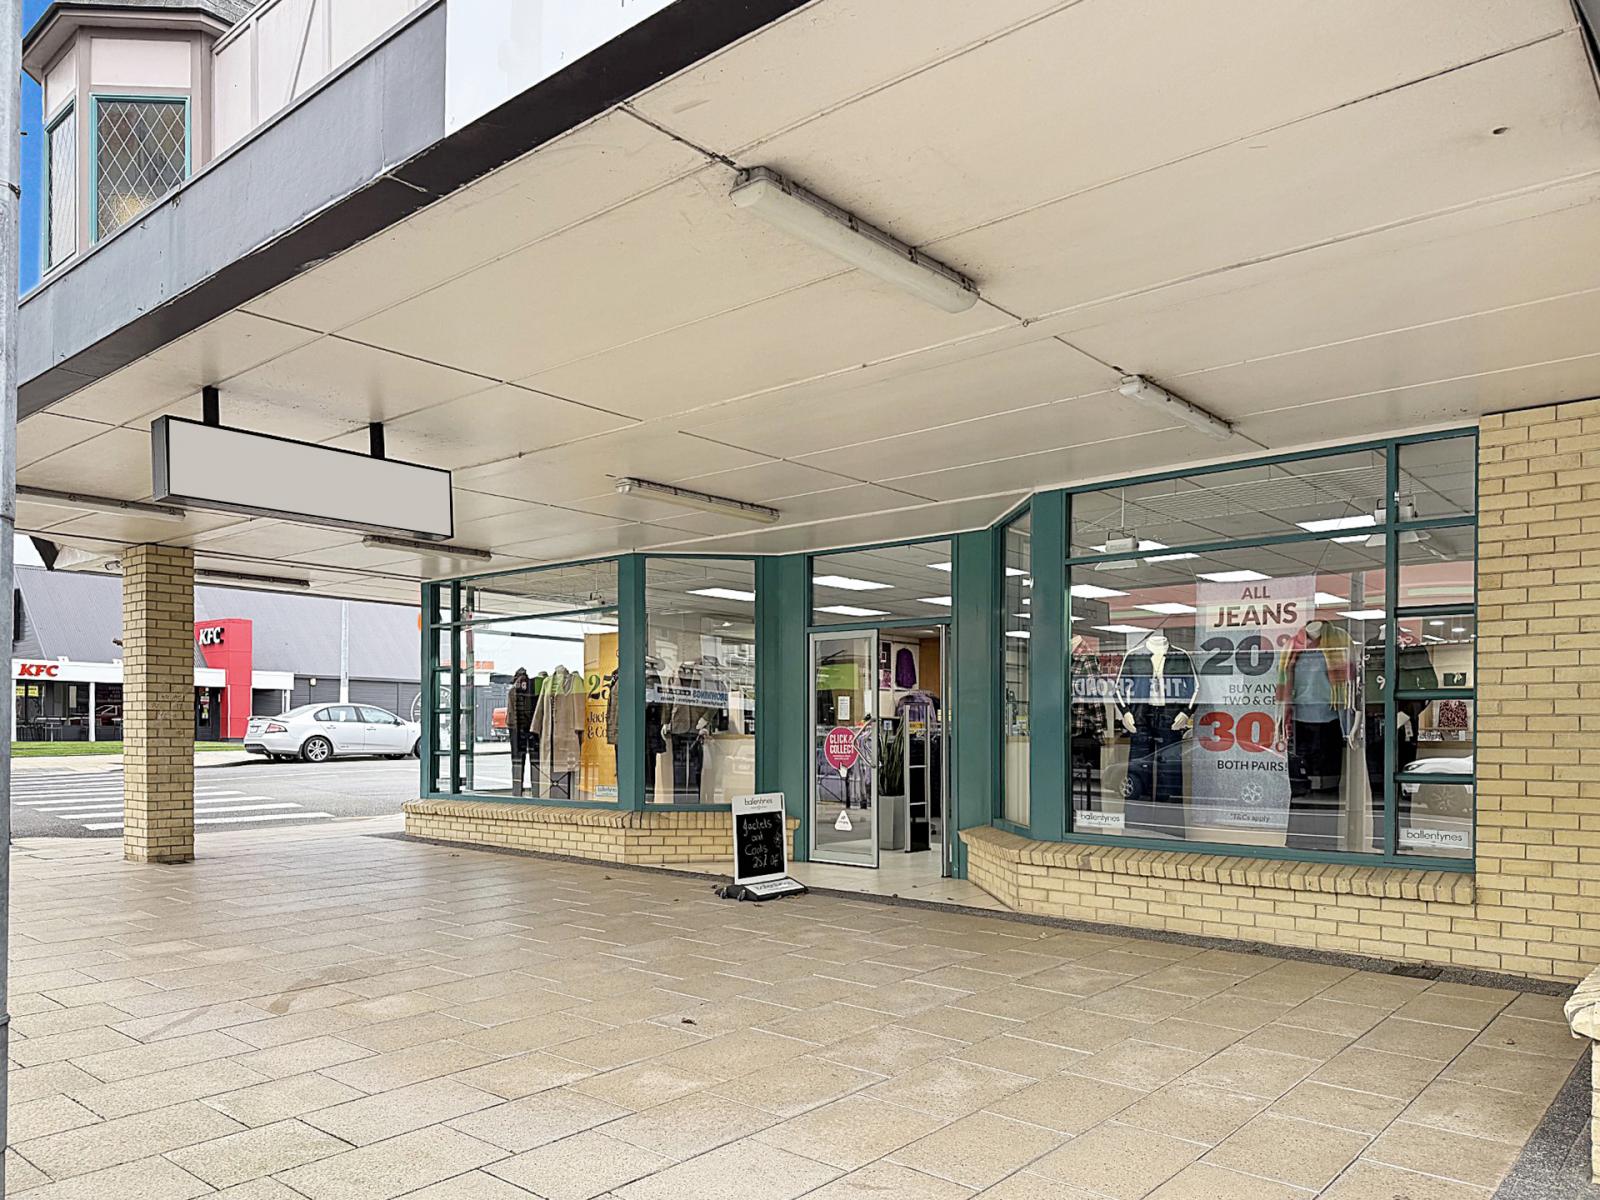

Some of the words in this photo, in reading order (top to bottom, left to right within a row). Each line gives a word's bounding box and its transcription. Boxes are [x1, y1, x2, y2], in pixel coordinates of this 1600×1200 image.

[1241, 586, 1271, 600] ALL
[1213, 602, 1298, 628] JEANS
[198, 627, 224, 646] KFC
[18, 664, 59, 677] KFC
[1229, 684, 1252, 694] BUY
[1254, 684, 1277, 694] ANY
[1223, 696, 1250, 706] TWO
[1252, 696, 1261, 705] &
[1263, 696, 1277, 705] GE
[829, 734, 848, 744] CLICK
[829, 744, 854, 754] COLLECT
[1217, 760, 1249, 770] BOTH
[1251, 761, 1288, 772] PAIRS!
[1406, 830, 1463, 842] ballentynes
